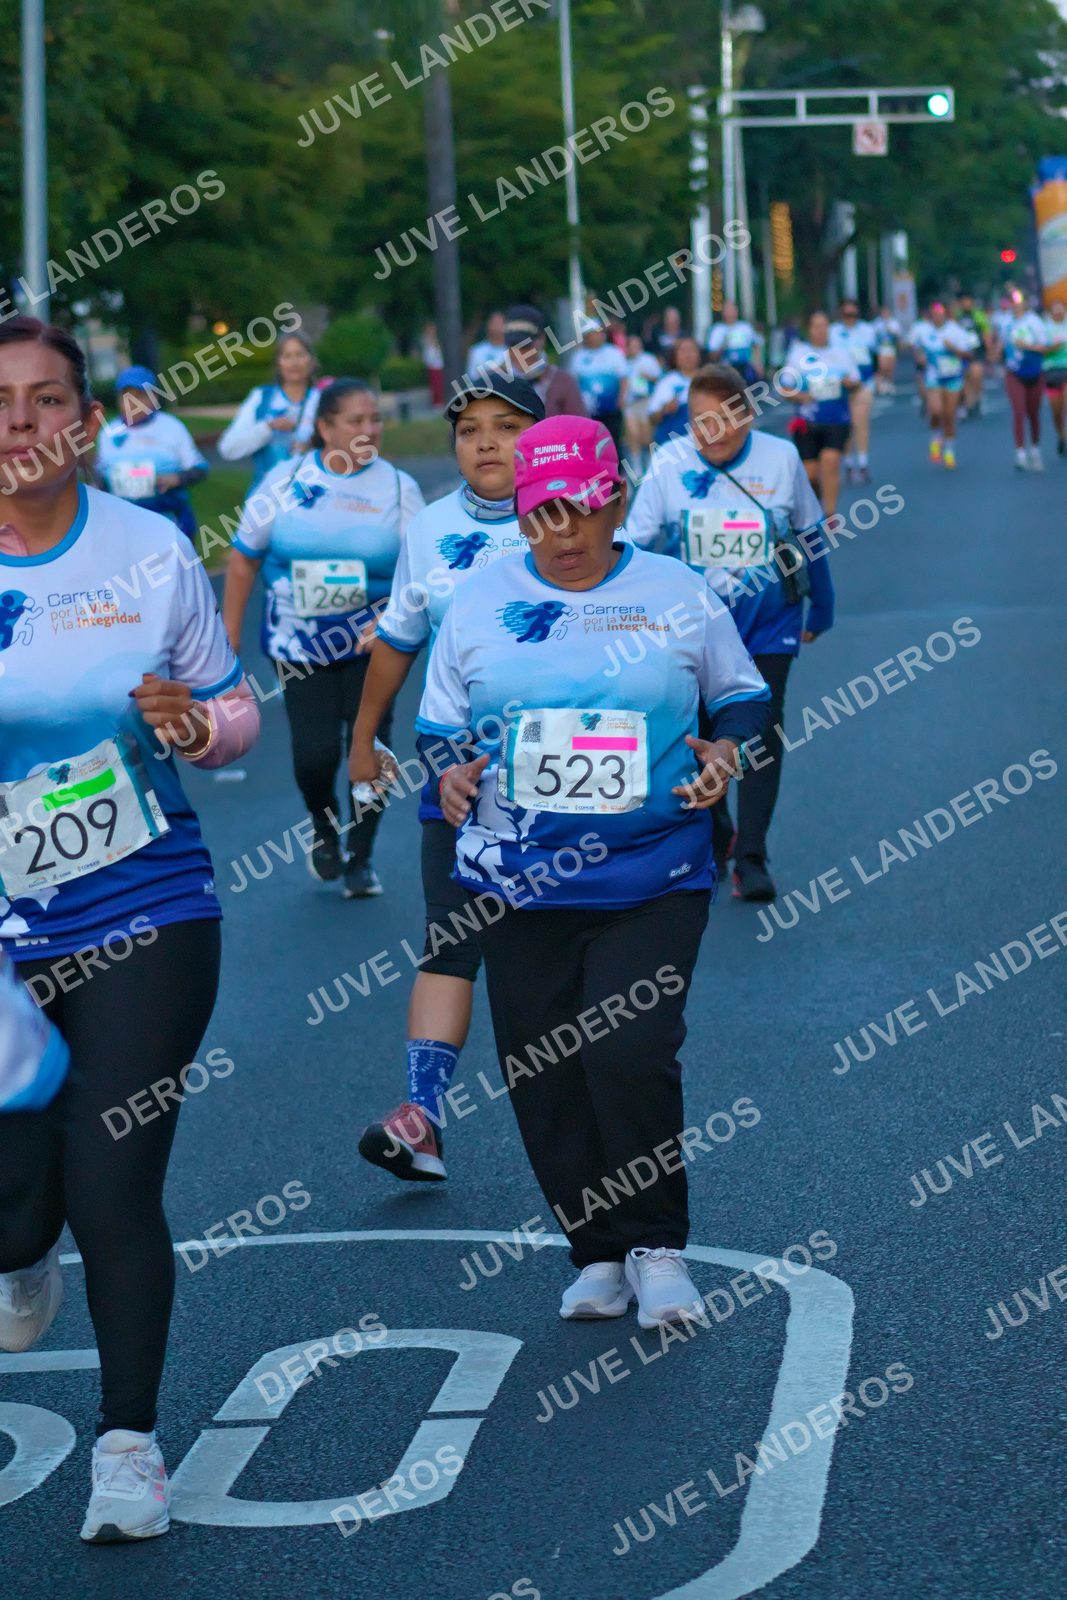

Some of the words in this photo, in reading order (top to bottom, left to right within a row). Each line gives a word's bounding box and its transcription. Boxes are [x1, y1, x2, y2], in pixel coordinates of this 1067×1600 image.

[534, 444, 566, 454] RUNNING
[532, 457, 539, 467] IS
[540, 456, 551, 465] MY
[552, 453, 569, 461] LIFE
[694, 532, 763, 558] 1549
[47, 589, 113, 607] Carrera
[298, 585, 367, 609] 1266
[51, 608, 67, 621] por
[75, 604, 86, 615] la
[88, 601, 118, 614] Vida
[583, 604, 645, 614] Carrera
[51, 623, 58, 635] y
[62, 619, 74, 631] la
[77, 612, 141, 628] Integridad
[584, 617, 601, 626] por
[606, 616, 617, 624] la
[584, 624, 590, 634] y
[593, 622, 603, 632] la
[607, 622, 670, 633] Integridad
[533, 754, 626, 799] 523
[14, 798, 117, 875] 209
